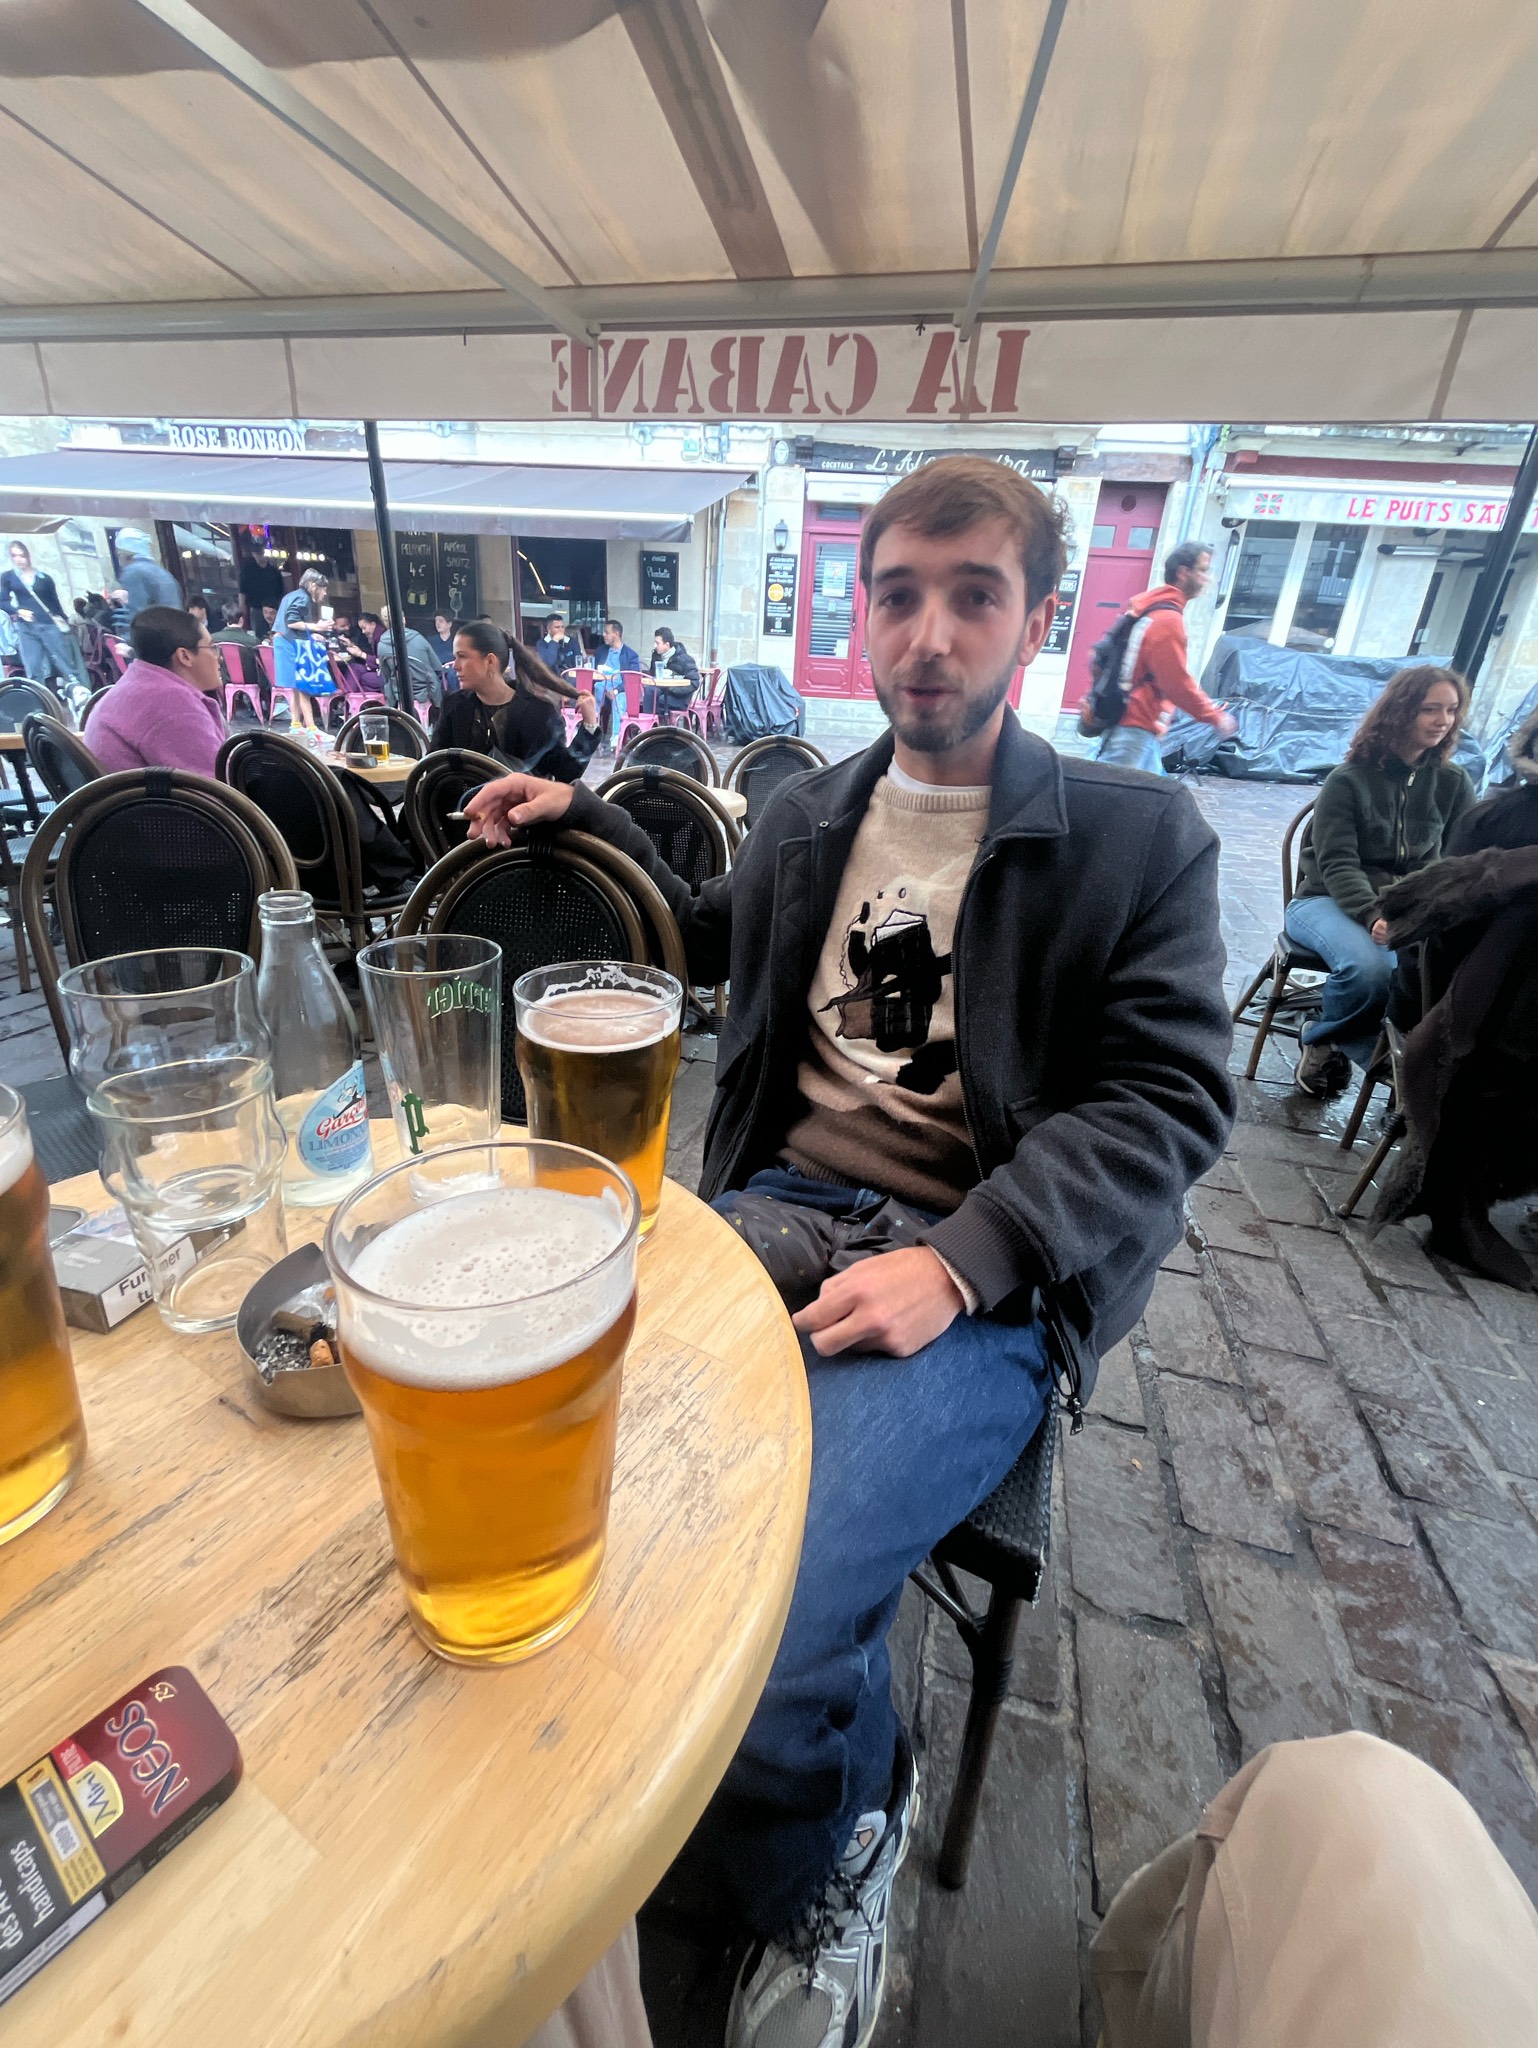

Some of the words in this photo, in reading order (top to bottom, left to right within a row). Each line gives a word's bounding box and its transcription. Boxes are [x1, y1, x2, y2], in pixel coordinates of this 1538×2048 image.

[168, 425, 221, 448] ROSE
[223, 427, 306, 451] BONBON
[1031, 469, 1047, 478] BAR
[1347, 497, 1377, 519] LE
[1386, 499, 1453, 523] PUITS
[104, 1699, 190, 1819] NEOS
[76, 1770, 117, 1826] Mini
[10, 1839, 57, 1929] handicaps
[0, 1912, 24, 1950] des
